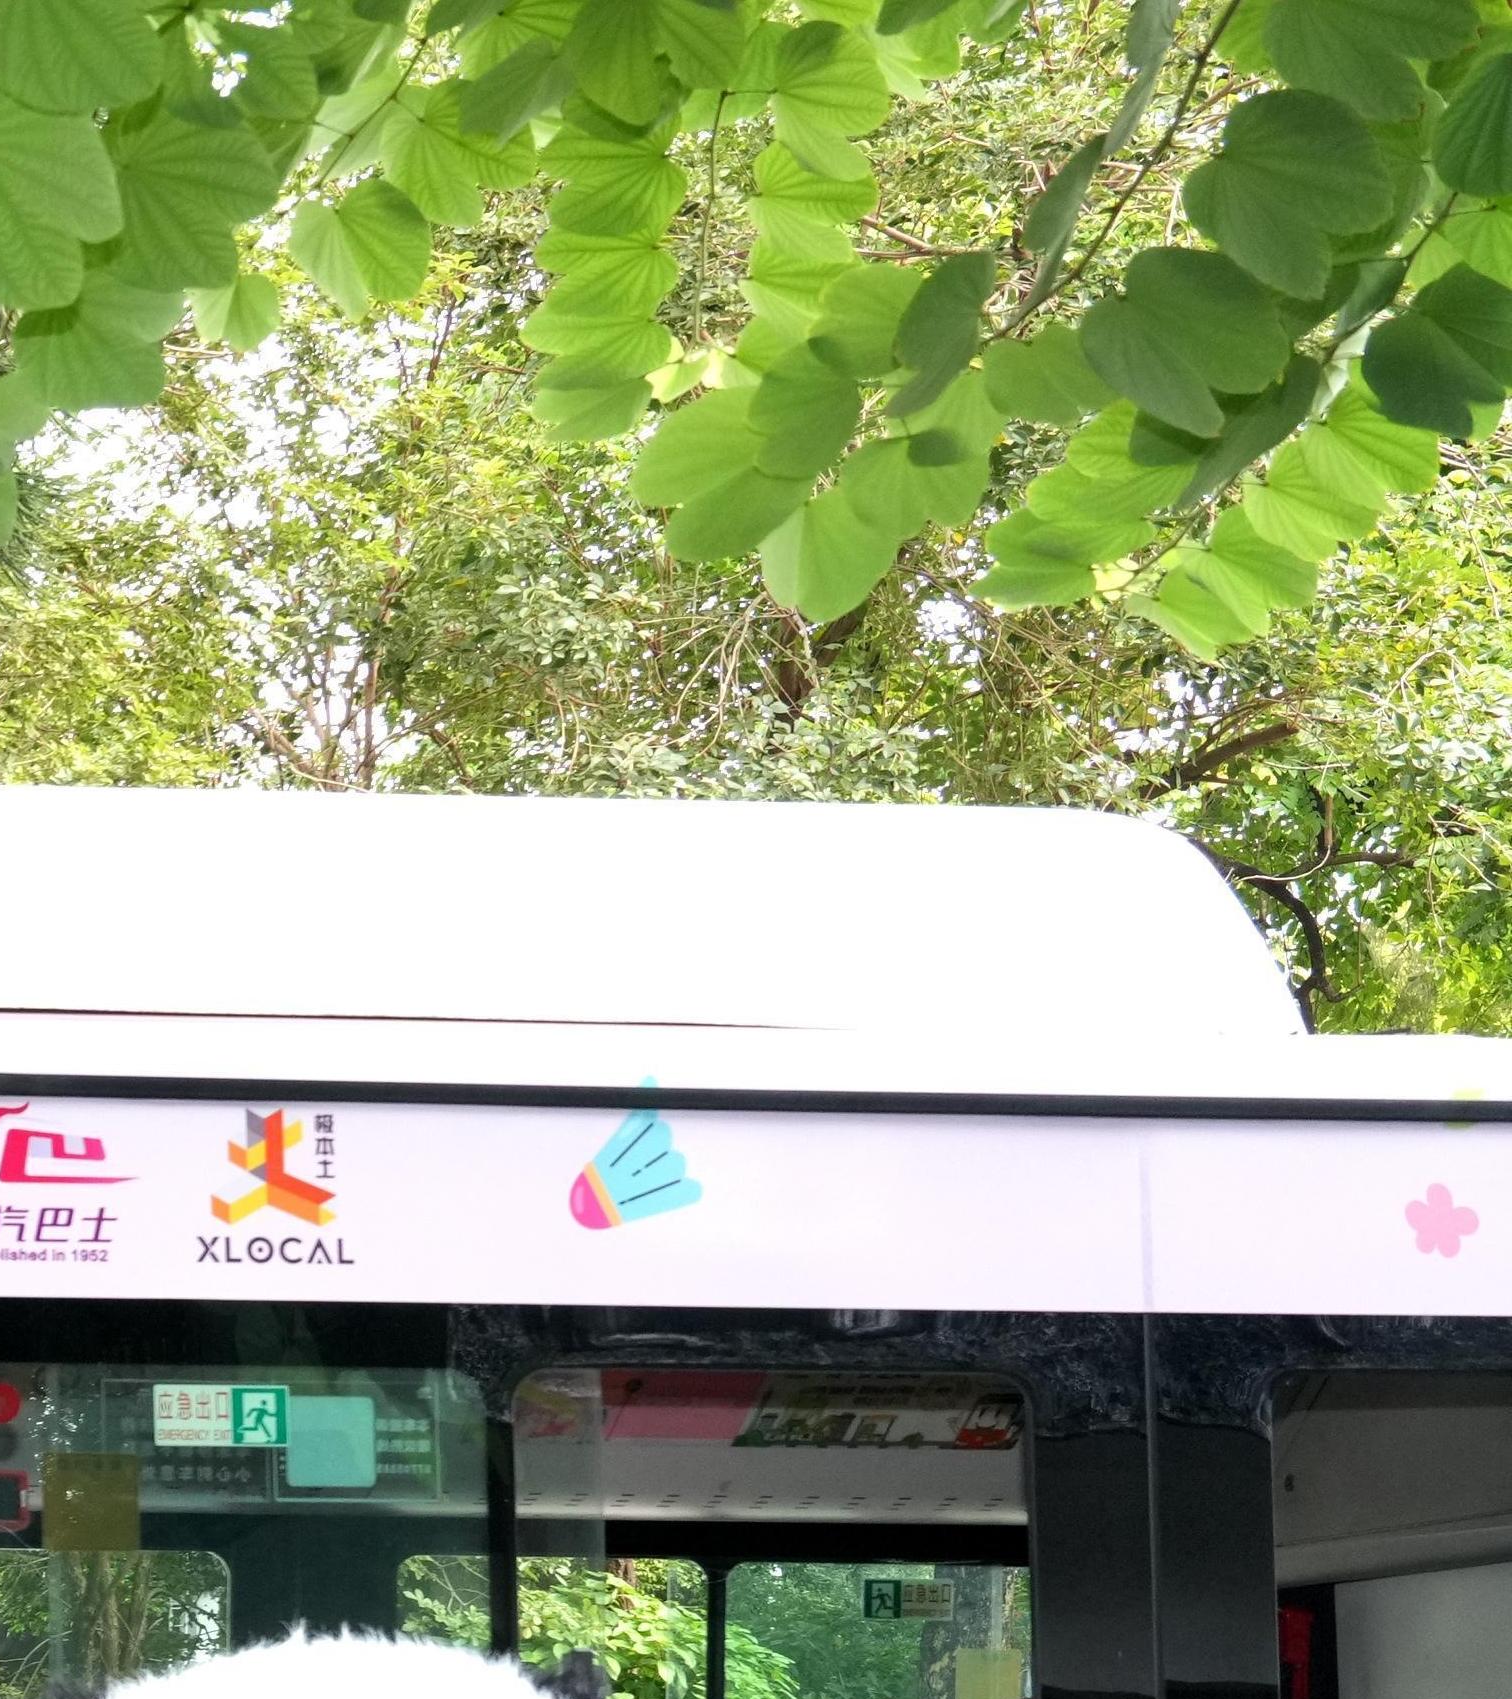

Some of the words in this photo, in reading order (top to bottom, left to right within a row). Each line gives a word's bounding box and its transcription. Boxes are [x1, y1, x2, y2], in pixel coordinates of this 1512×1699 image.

[52, 1249, 66, 1261] in
[72, 1249, 109, 1262] 1952
[196, 1235, 355, 1265] XLOCAL
[159, 1391, 229, 1420] 应急出口
